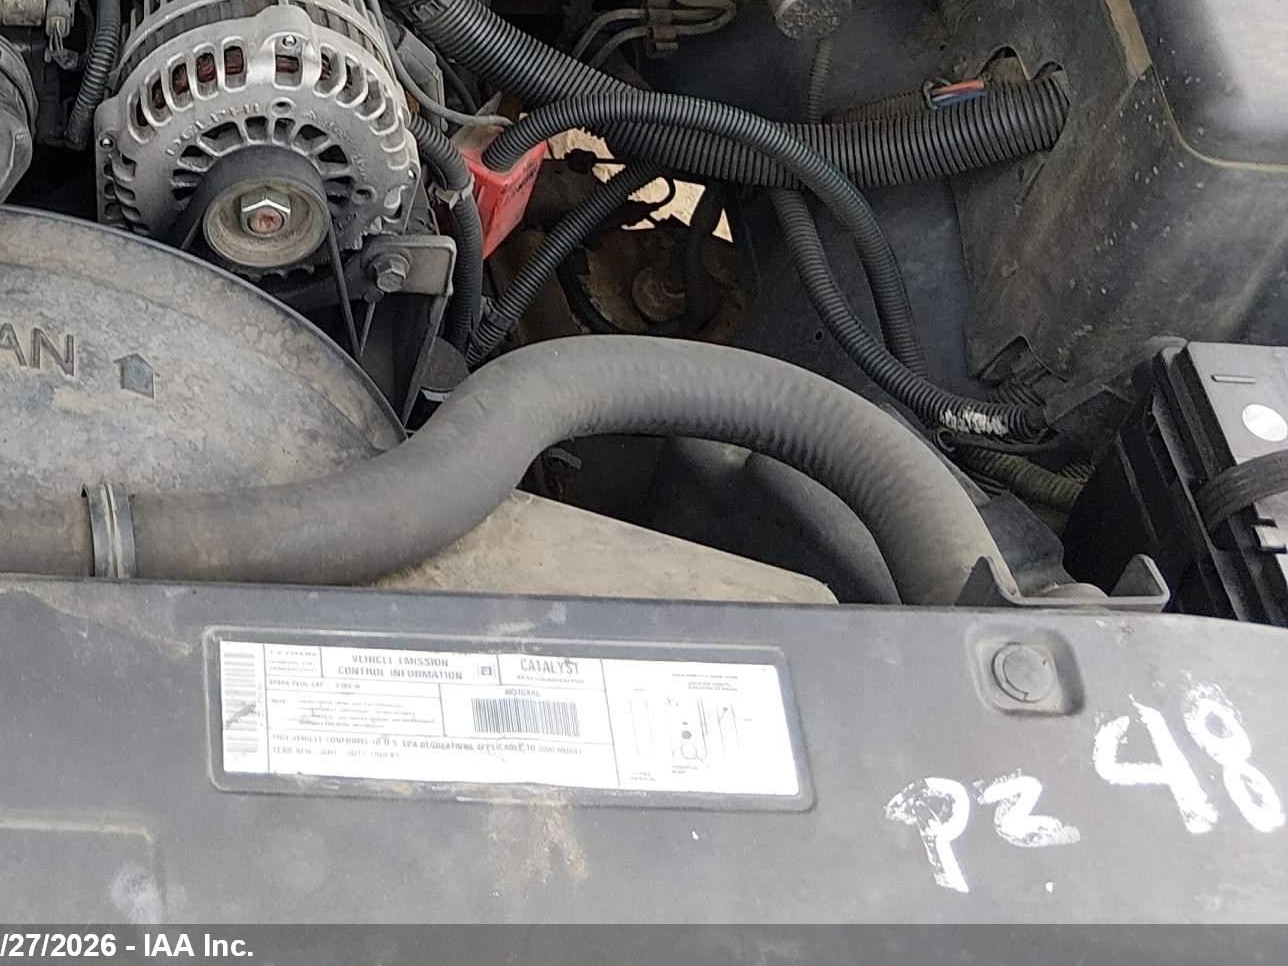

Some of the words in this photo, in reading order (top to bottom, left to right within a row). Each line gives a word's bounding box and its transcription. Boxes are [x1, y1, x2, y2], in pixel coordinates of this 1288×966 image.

[398, 656, 449, 668] EMISSION
[520, 658, 580, 675] CATALYST
[338, 666, 384, 677] CONTROL
[389, 668, 464, 681] INFORMATION
[1092, 682, 1285, 834] 48
